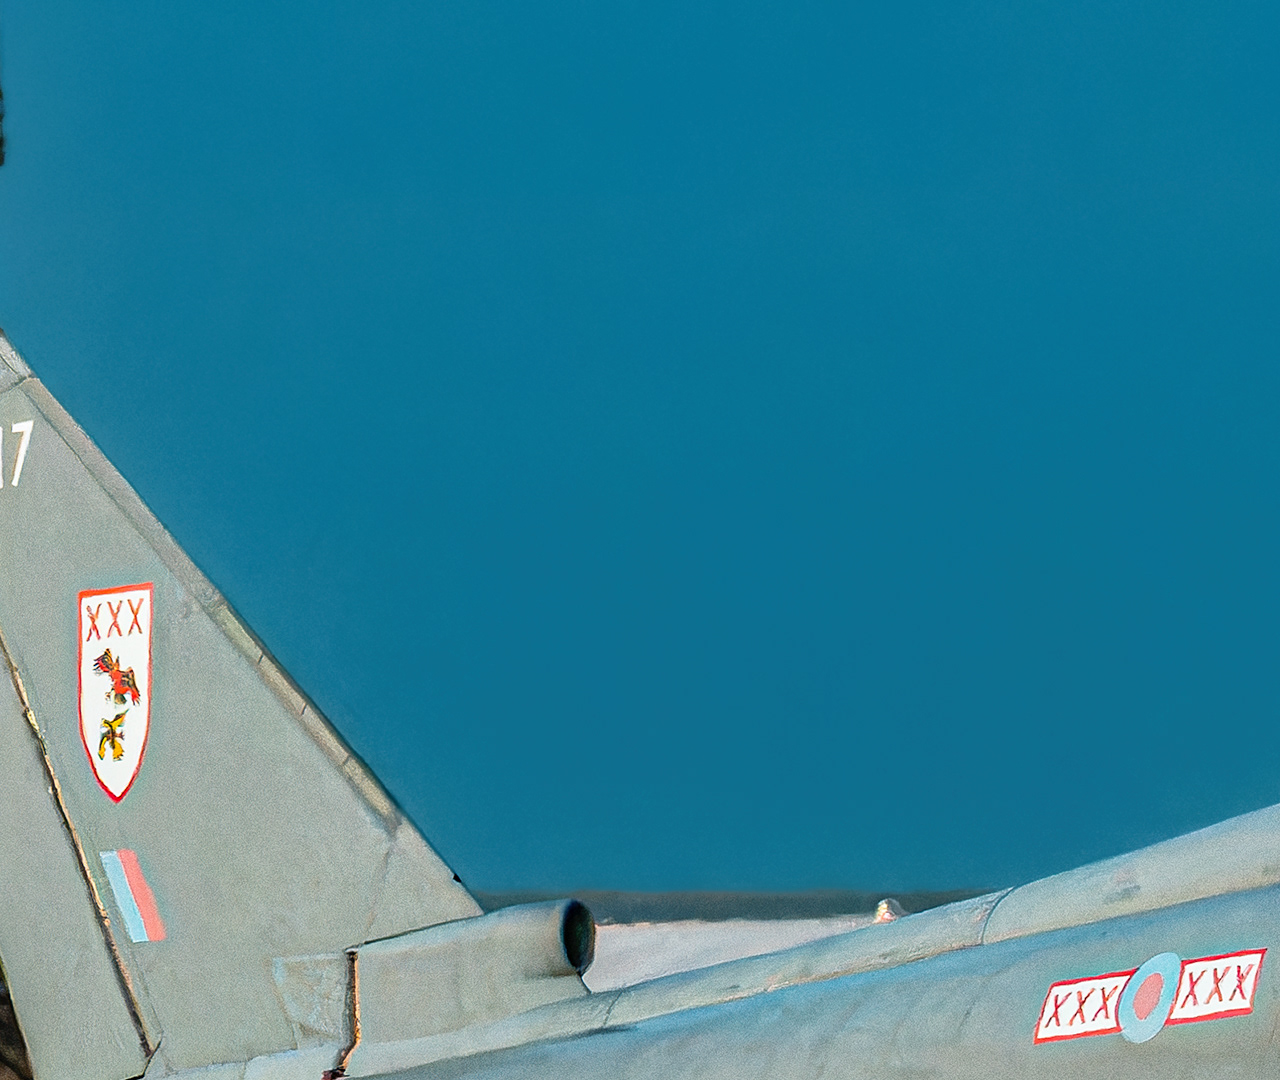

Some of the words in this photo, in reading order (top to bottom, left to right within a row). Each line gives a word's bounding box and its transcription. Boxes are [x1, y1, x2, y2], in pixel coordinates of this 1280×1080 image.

[86, 598, 144, 642] XXX
[1044, 985, 1119, 1029] XXX
[1180, 963, 1255, 1009] XXX
